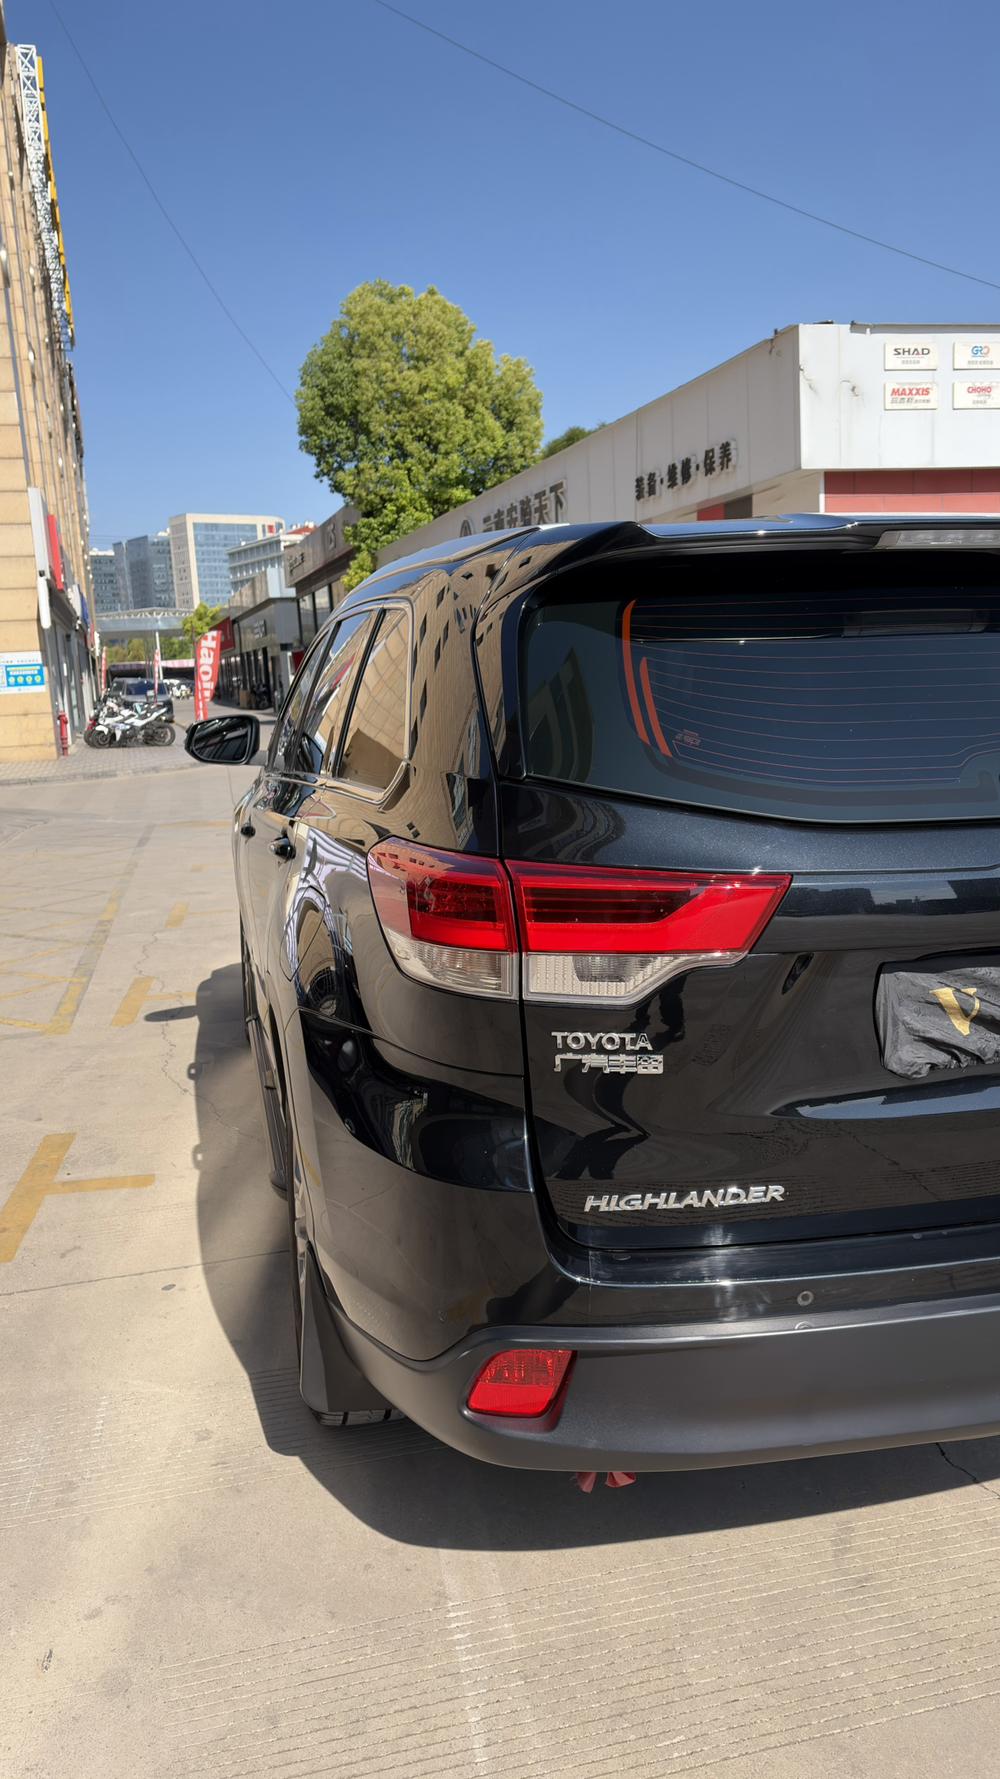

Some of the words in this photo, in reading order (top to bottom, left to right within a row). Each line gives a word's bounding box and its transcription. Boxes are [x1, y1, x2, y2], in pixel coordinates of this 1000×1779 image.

[893, 347, 931, 356] SHAD
[890, 387, 931, 397] MAXXIS
[967, 386, 992, 394] CHOHO
[551, 1031, 653, 1051] TOYOTA
[553, 1052, 664, 1075] 广汽丰田
[583, 1184, 786, 1213] HIGHLANDER
